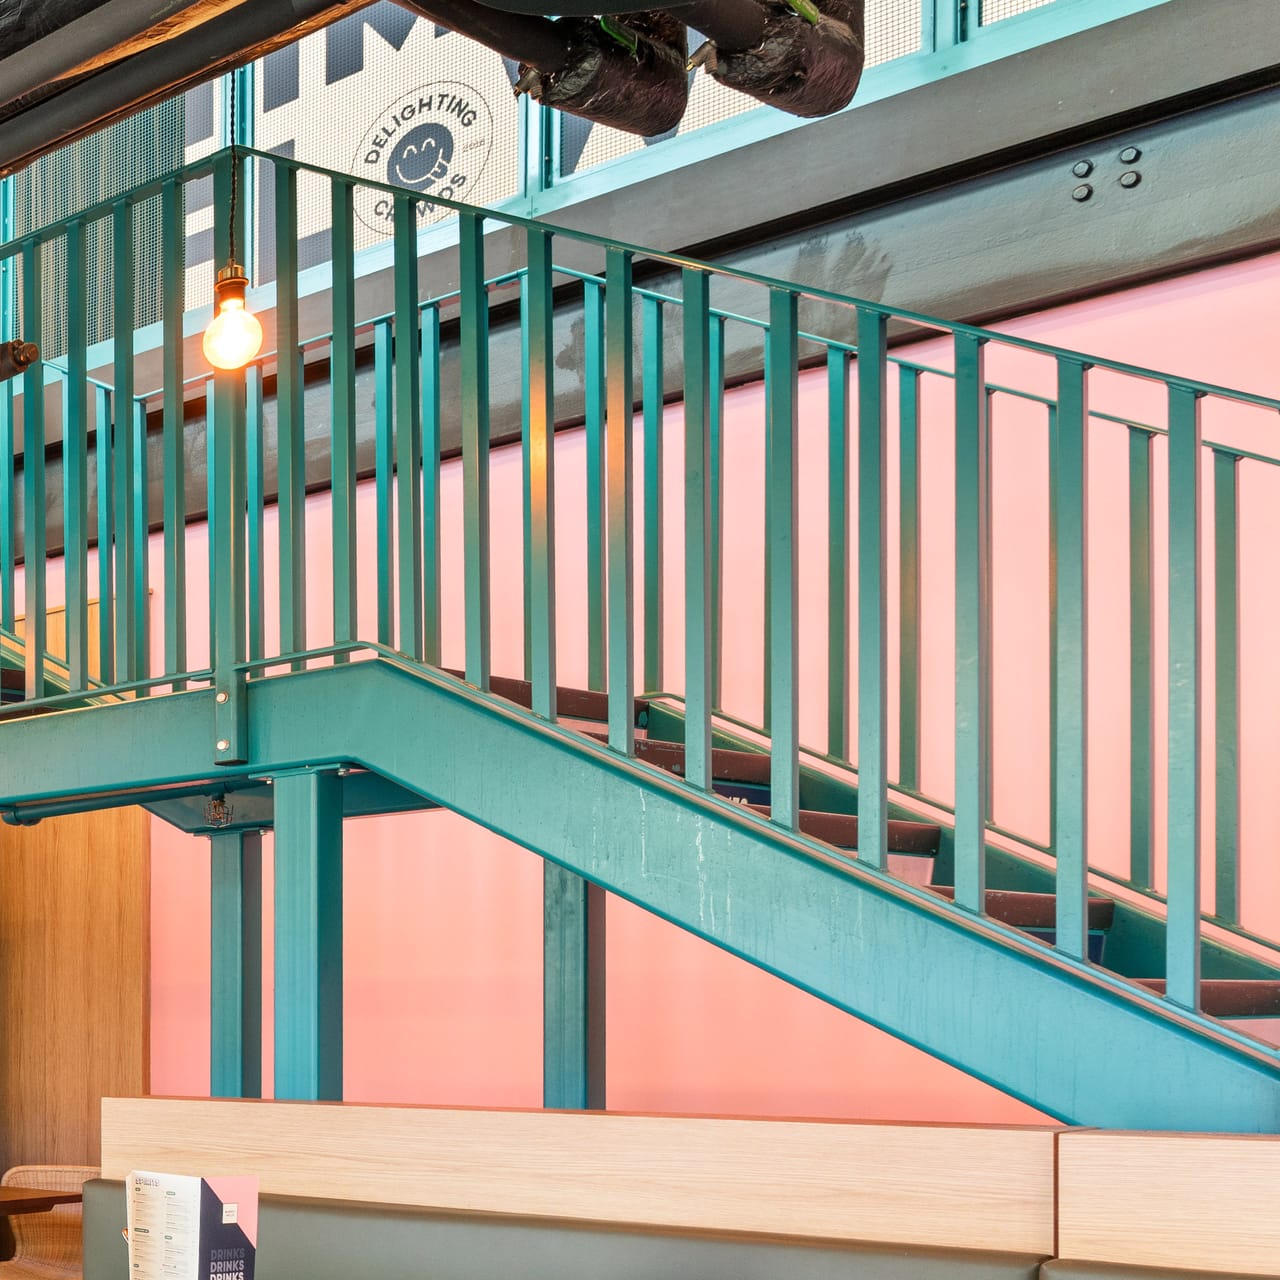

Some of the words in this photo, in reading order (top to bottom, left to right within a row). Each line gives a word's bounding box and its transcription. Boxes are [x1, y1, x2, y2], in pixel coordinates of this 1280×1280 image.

[364, 93, 477, 164] DELIGHTING
[374, 173, 466, 223] CWDS
[210, 1260, 244, 1273] DRINKS
[211, 1248, 245, 1261] DRINKS
